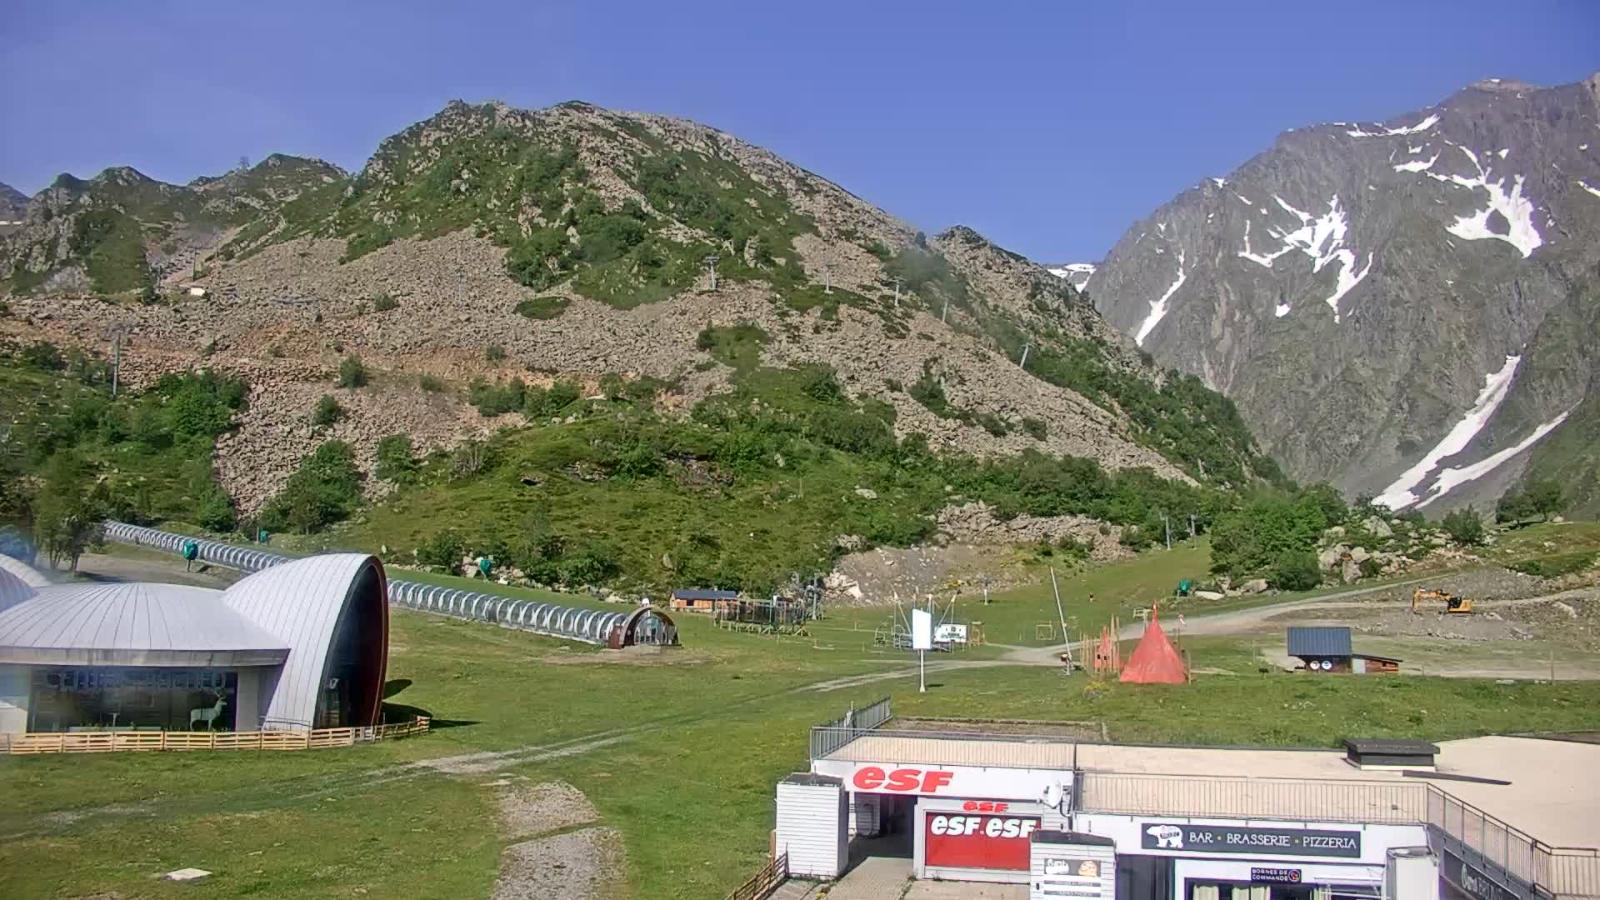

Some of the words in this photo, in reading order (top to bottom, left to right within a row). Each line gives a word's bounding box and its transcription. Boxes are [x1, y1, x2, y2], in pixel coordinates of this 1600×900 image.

[1189, 832, 1214, 844] BAR
[1226, 833, 1291, 847] BRASSERIE
[1302, 836, 1357, 849] PIZZERIA
